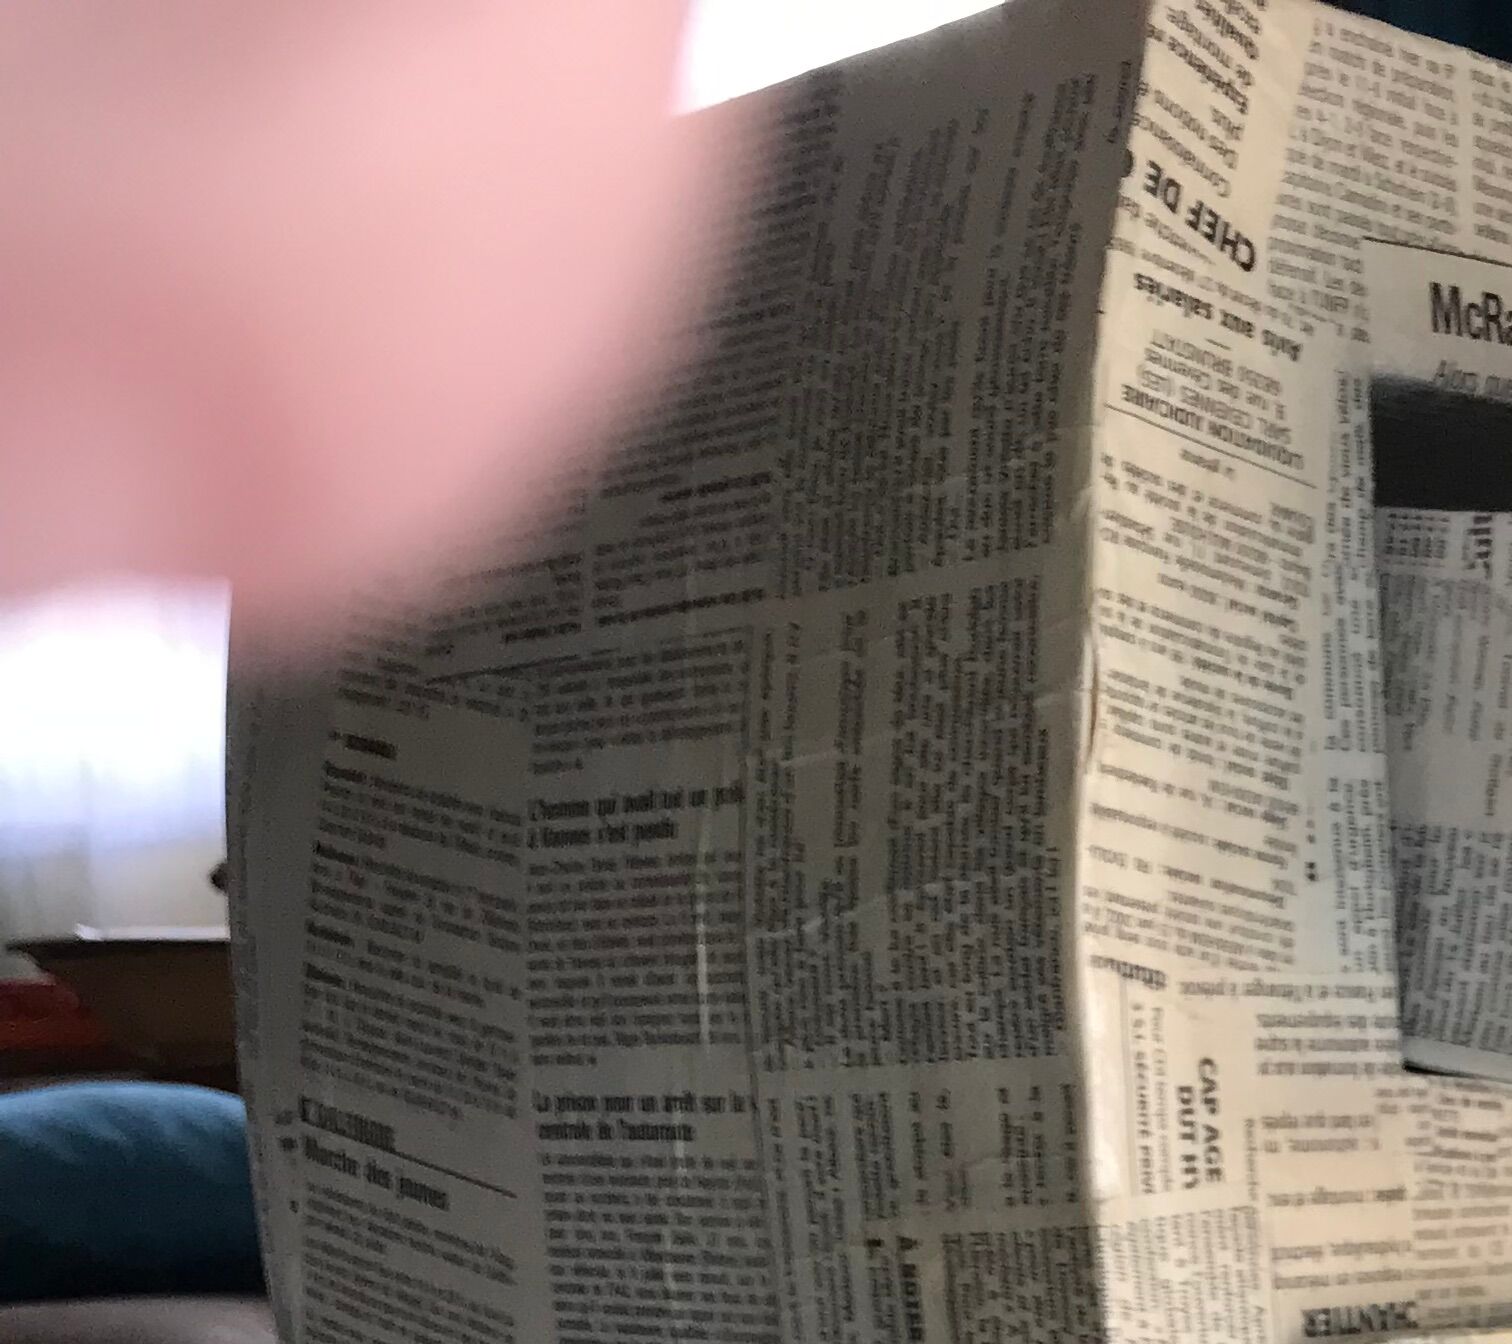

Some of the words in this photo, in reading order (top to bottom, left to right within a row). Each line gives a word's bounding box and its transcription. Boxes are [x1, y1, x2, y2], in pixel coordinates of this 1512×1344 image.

[1143, 159, 1182, 214] DE
[1185, 199, 1255, 272] CHEF
[1175, 1084, 1199, 1144] DUT
[1198, 1057, 1221, 1117] CAP
[1201, 1123, 1224, 1184] AGE
